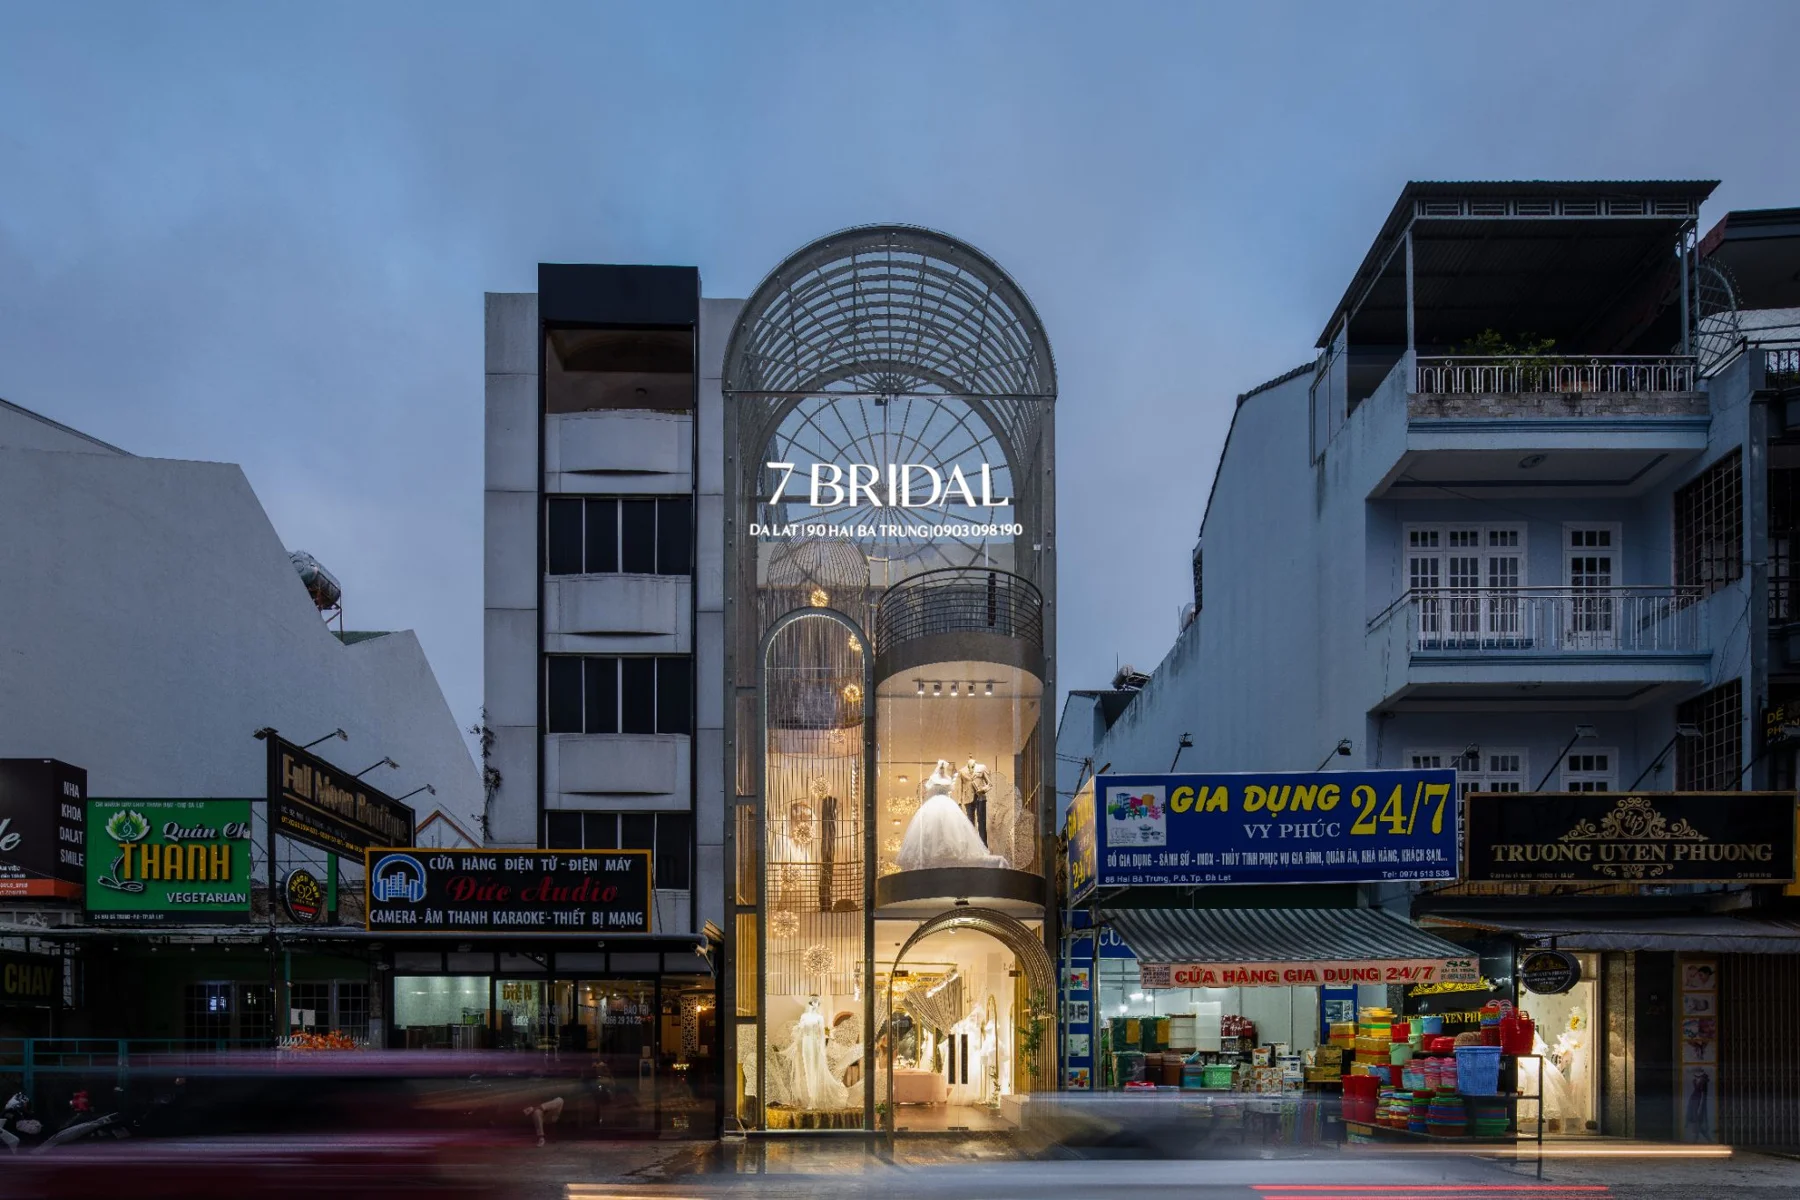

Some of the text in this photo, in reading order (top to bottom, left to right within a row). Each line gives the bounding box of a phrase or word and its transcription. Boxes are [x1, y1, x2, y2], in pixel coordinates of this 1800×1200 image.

[766, 462, 1009, 507] 7 BRIDAL
[750, 523, 770, 537] DA
[773, 523, 799, 537] LAT
[806, 524, 826, 537] 90
[828, 524, 854, 537] HAI
[857, 524, 877, 537] BA
[879, 524, 928, 538] TRUNG
[282, 752, 313, 800] Full
[63, 780, 80, 799] NHA
[61, 802, 83, 822] KHOA
[1169, 780, 1451, 835] GIA DỤNG 24/7
[59, 825, 83, 845] DALAT
[163, 821, 218, 843] Quán
[1243, 817, 1341, 839] VY PHÚC
[59, 848, 84, 868] SMILE
[118, 843, 230, 880] THANH
[1119, 853, 1131, 867] GIA
[1132, 853, 1152, 871] DỤNG
[1197, 852, 1214, 866] INOX
[1242, 852, 1258, 866] TINH
[1291, 851, 1304, 865] GIA
[1325, 848, 1346, 865] QUÁN
[1401, 846, 1425, 862] KHÁCH
[1490, 844, 1774, 862] TRUONG UYEN PHUONG
[429, 854, 455, 870] CỬA
[462, 856, 497, 871] HÀNG
[504, 856, 534, 874] ĐIỆN
[540, 855, 558, 871] TỬ
[568, 856, 598, 874] ĐIỆN
[605, 856, 632, 871] MÁY
[1399, 870, 1418, 878] 0974
[1420, 870, 1434, 878] 513
[166, 892, 247, 903] VEGETARIAN
[297, 884, 313, 900] 92
[446, 874, 618, 902] Đức Audio
[370, 909, 417, 924] CAMERA
[424, 908, 443, 924] ÂM
[447, 910, 488, 925] THANH
[493, 911, 545, 925] KARAOKE
[553, 908, 586, 925] THIẾT
[592, 911, 604, 928] BỊ
[608, 911, 643, 928] MẠNG
[4, 962, 55, 997] CHAY
[1174, 966, 1217, 983] CỬA
[1222, 966, 1280, 984] HÀNG
[1284, 969, 1319, 983] GIA
[1323, 967, 1382, 984] DỤNG
[1386, 966, 1436, 981] 24/7
